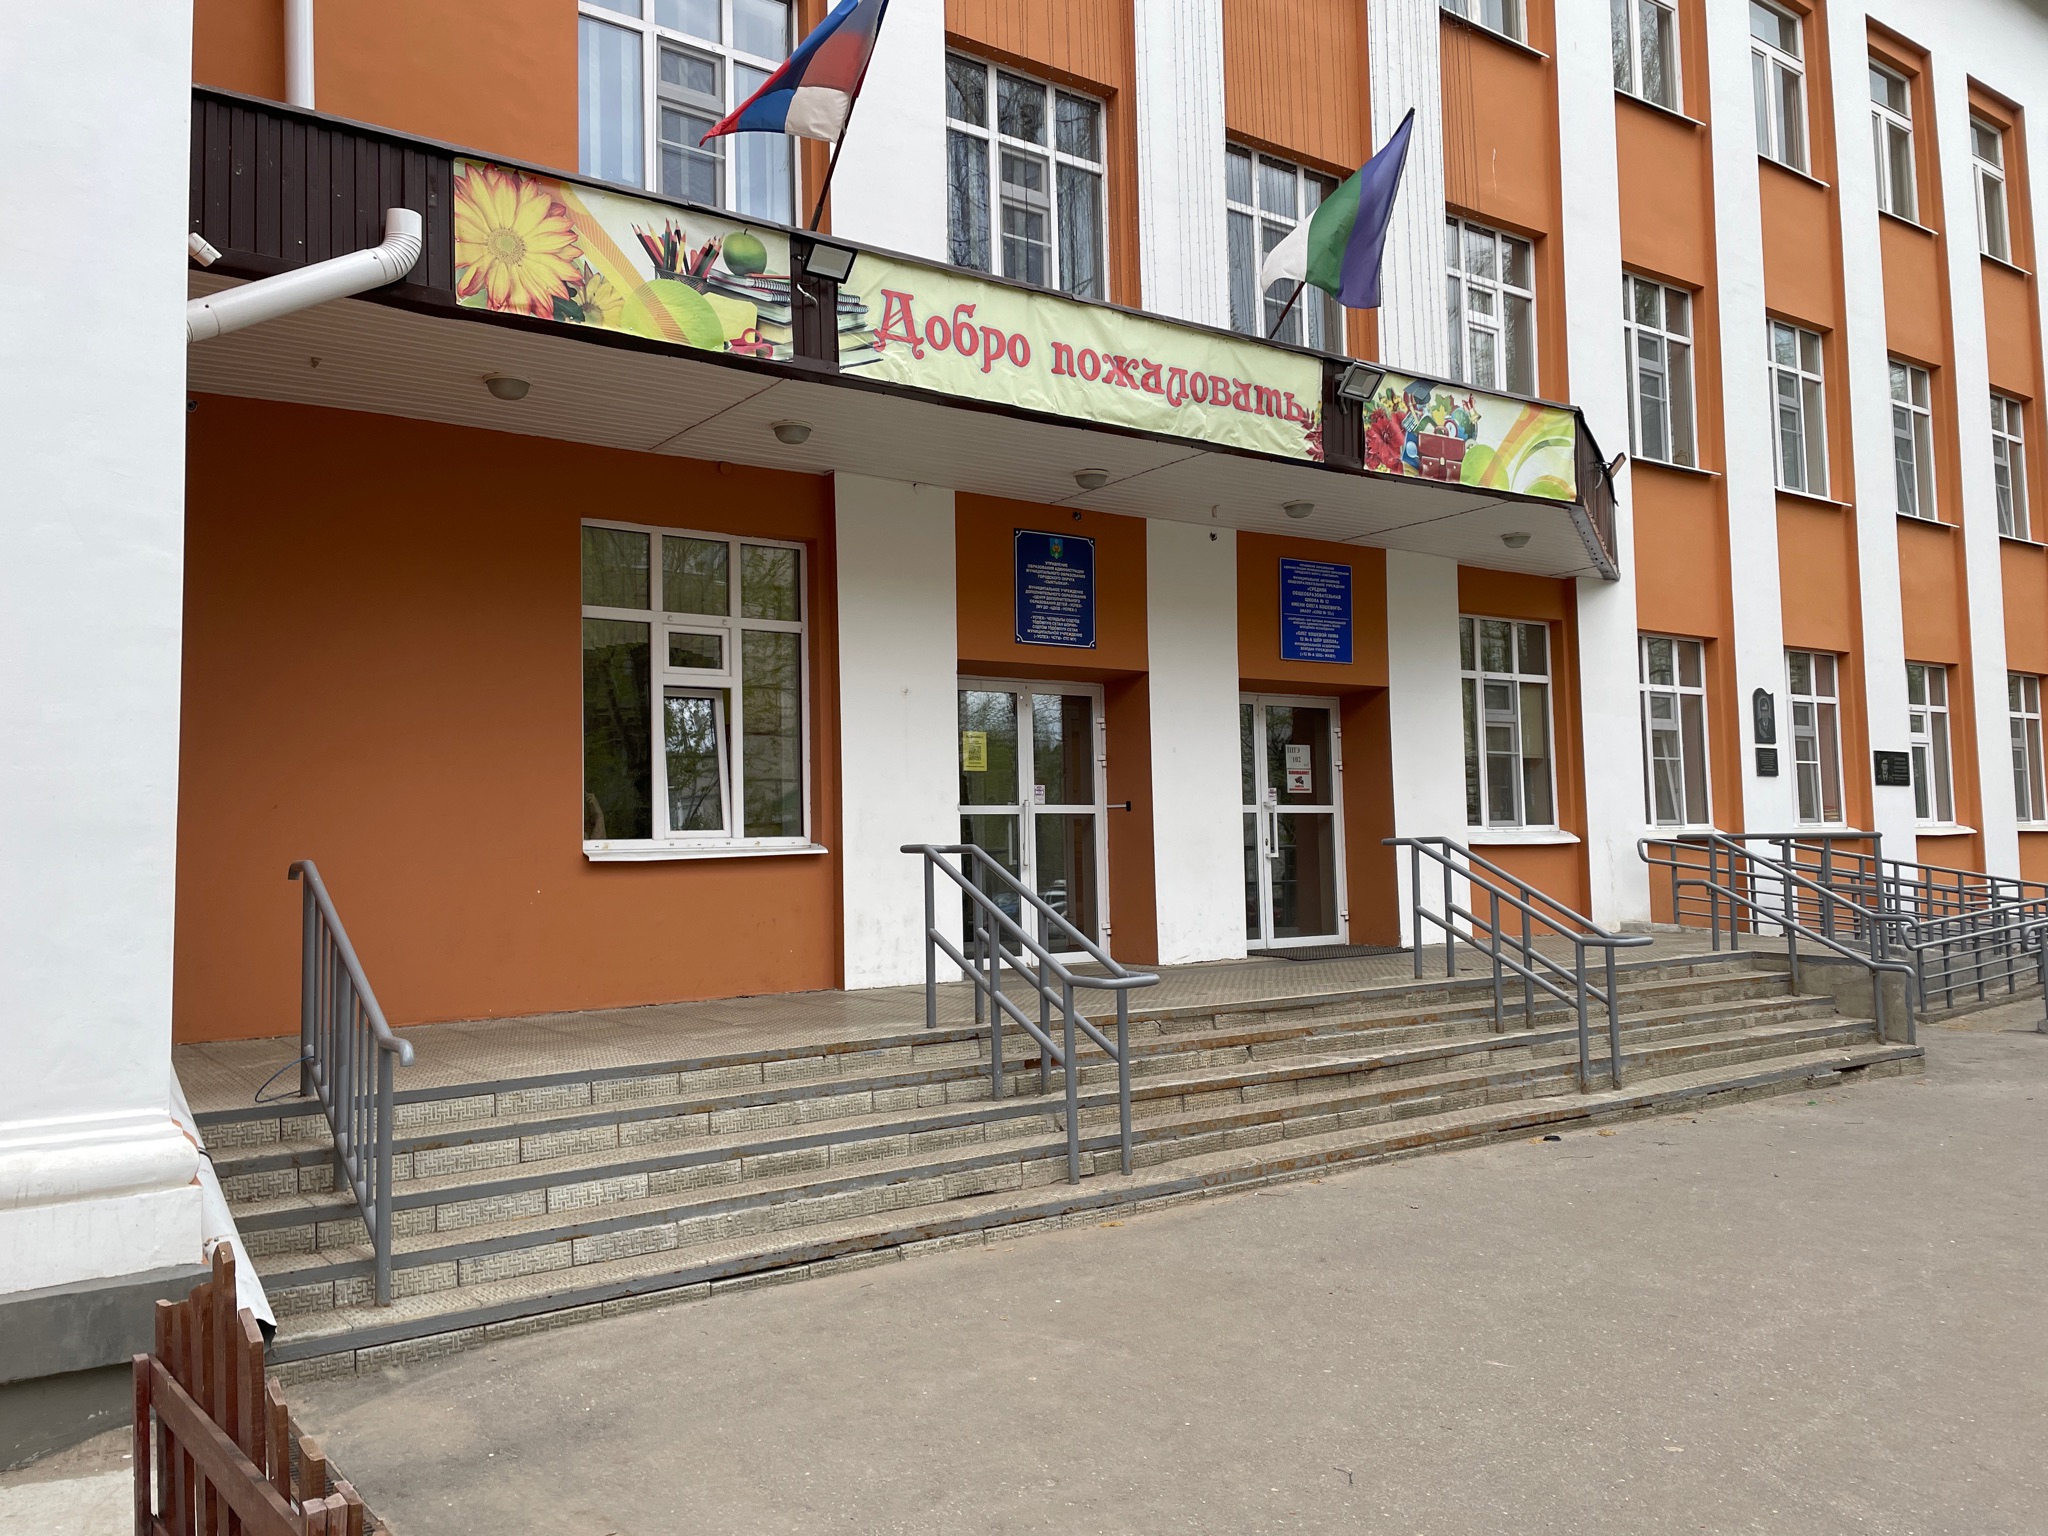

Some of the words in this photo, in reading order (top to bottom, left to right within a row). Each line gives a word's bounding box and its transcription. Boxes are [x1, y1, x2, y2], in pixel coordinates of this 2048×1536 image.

[872, 288, 1031, 374] Добро
[1051, 340, 1306, 422] пожаловать
[1292, 590, 1341, 600] ОБЩЕОБРАЗОВАТЕЛЬНАЯ
